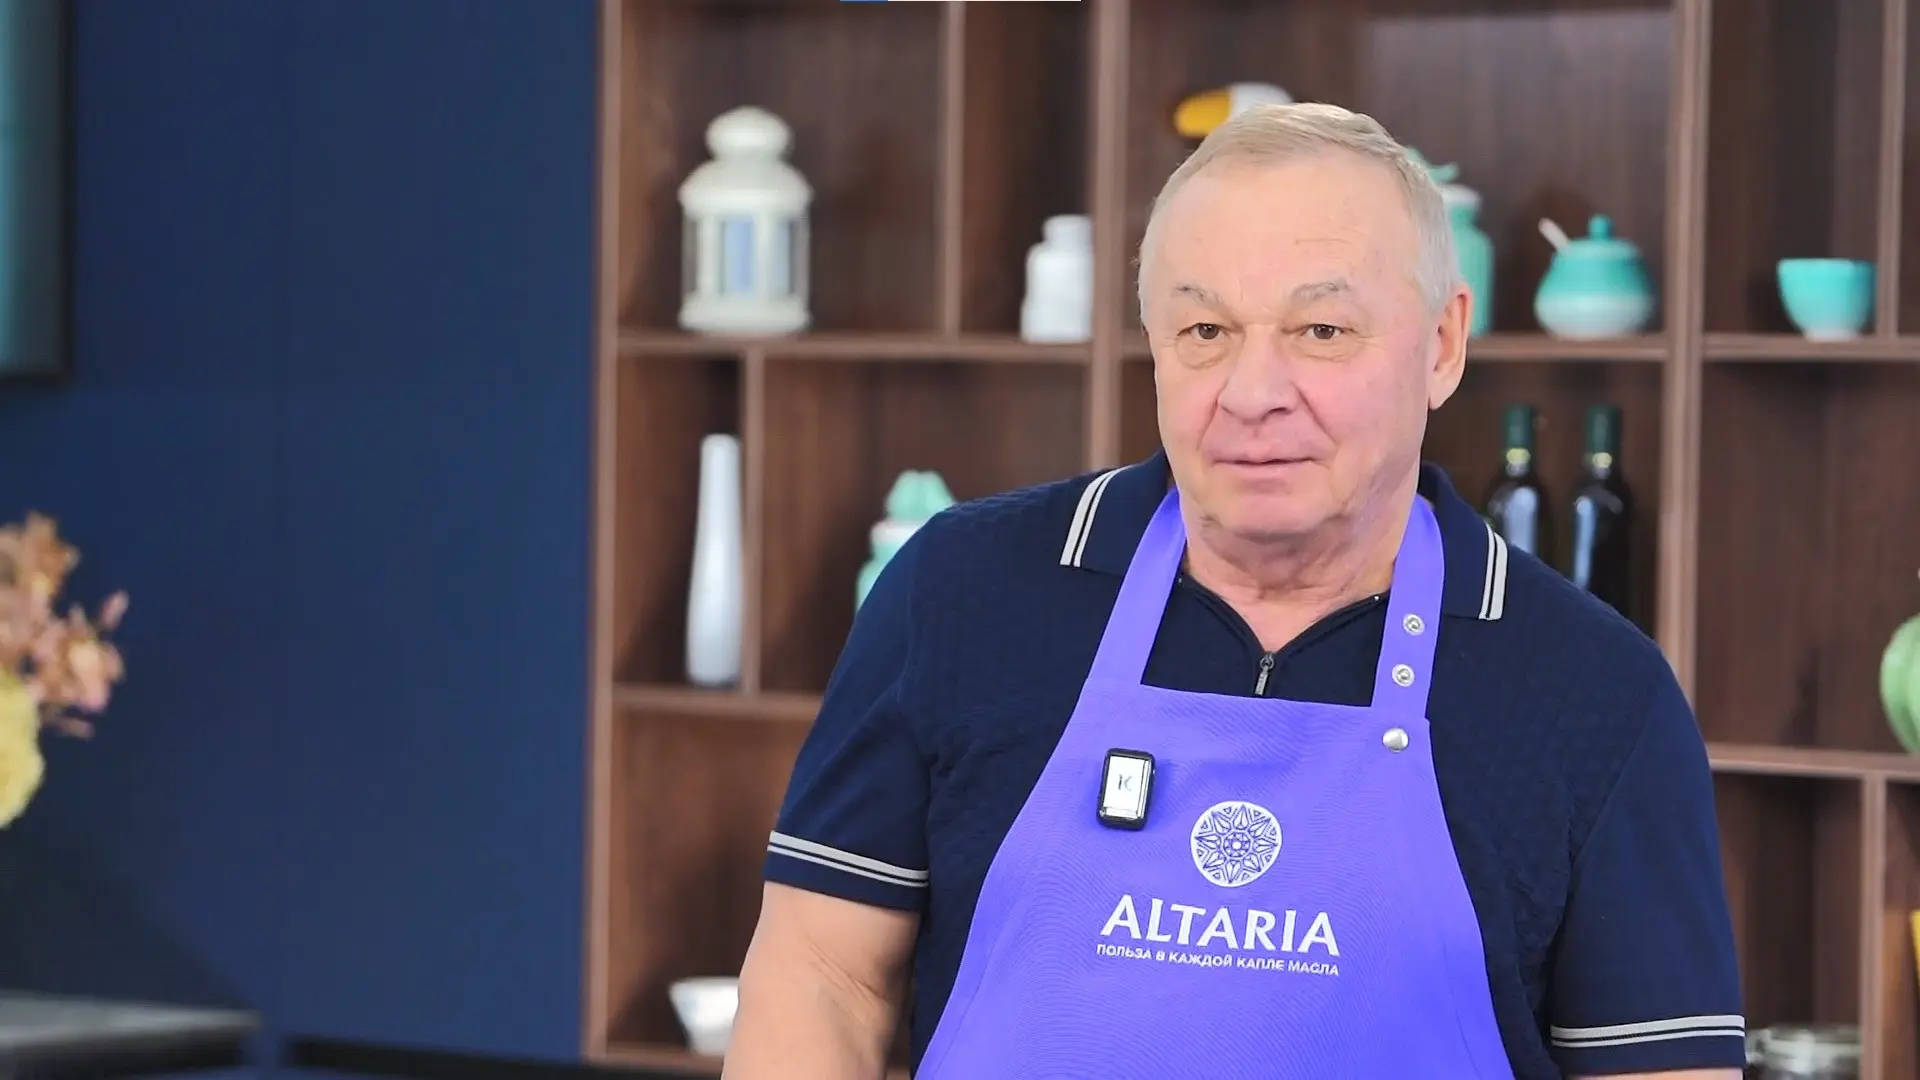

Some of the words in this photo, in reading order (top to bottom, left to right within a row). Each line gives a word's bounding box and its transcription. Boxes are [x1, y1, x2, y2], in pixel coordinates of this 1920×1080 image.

[1100, 894, 1340, 957] ALTARIA
[1096, 943, 1152, 960] ПОЛЬЗА
[1155, 950, 1166, 961] В
[1168, 952, 1233, 968] КАЖДОЙ
[1236, 957, 1285, 971] КАПЛЕ
[1287, 960, 1339, 976] МАСЛА
